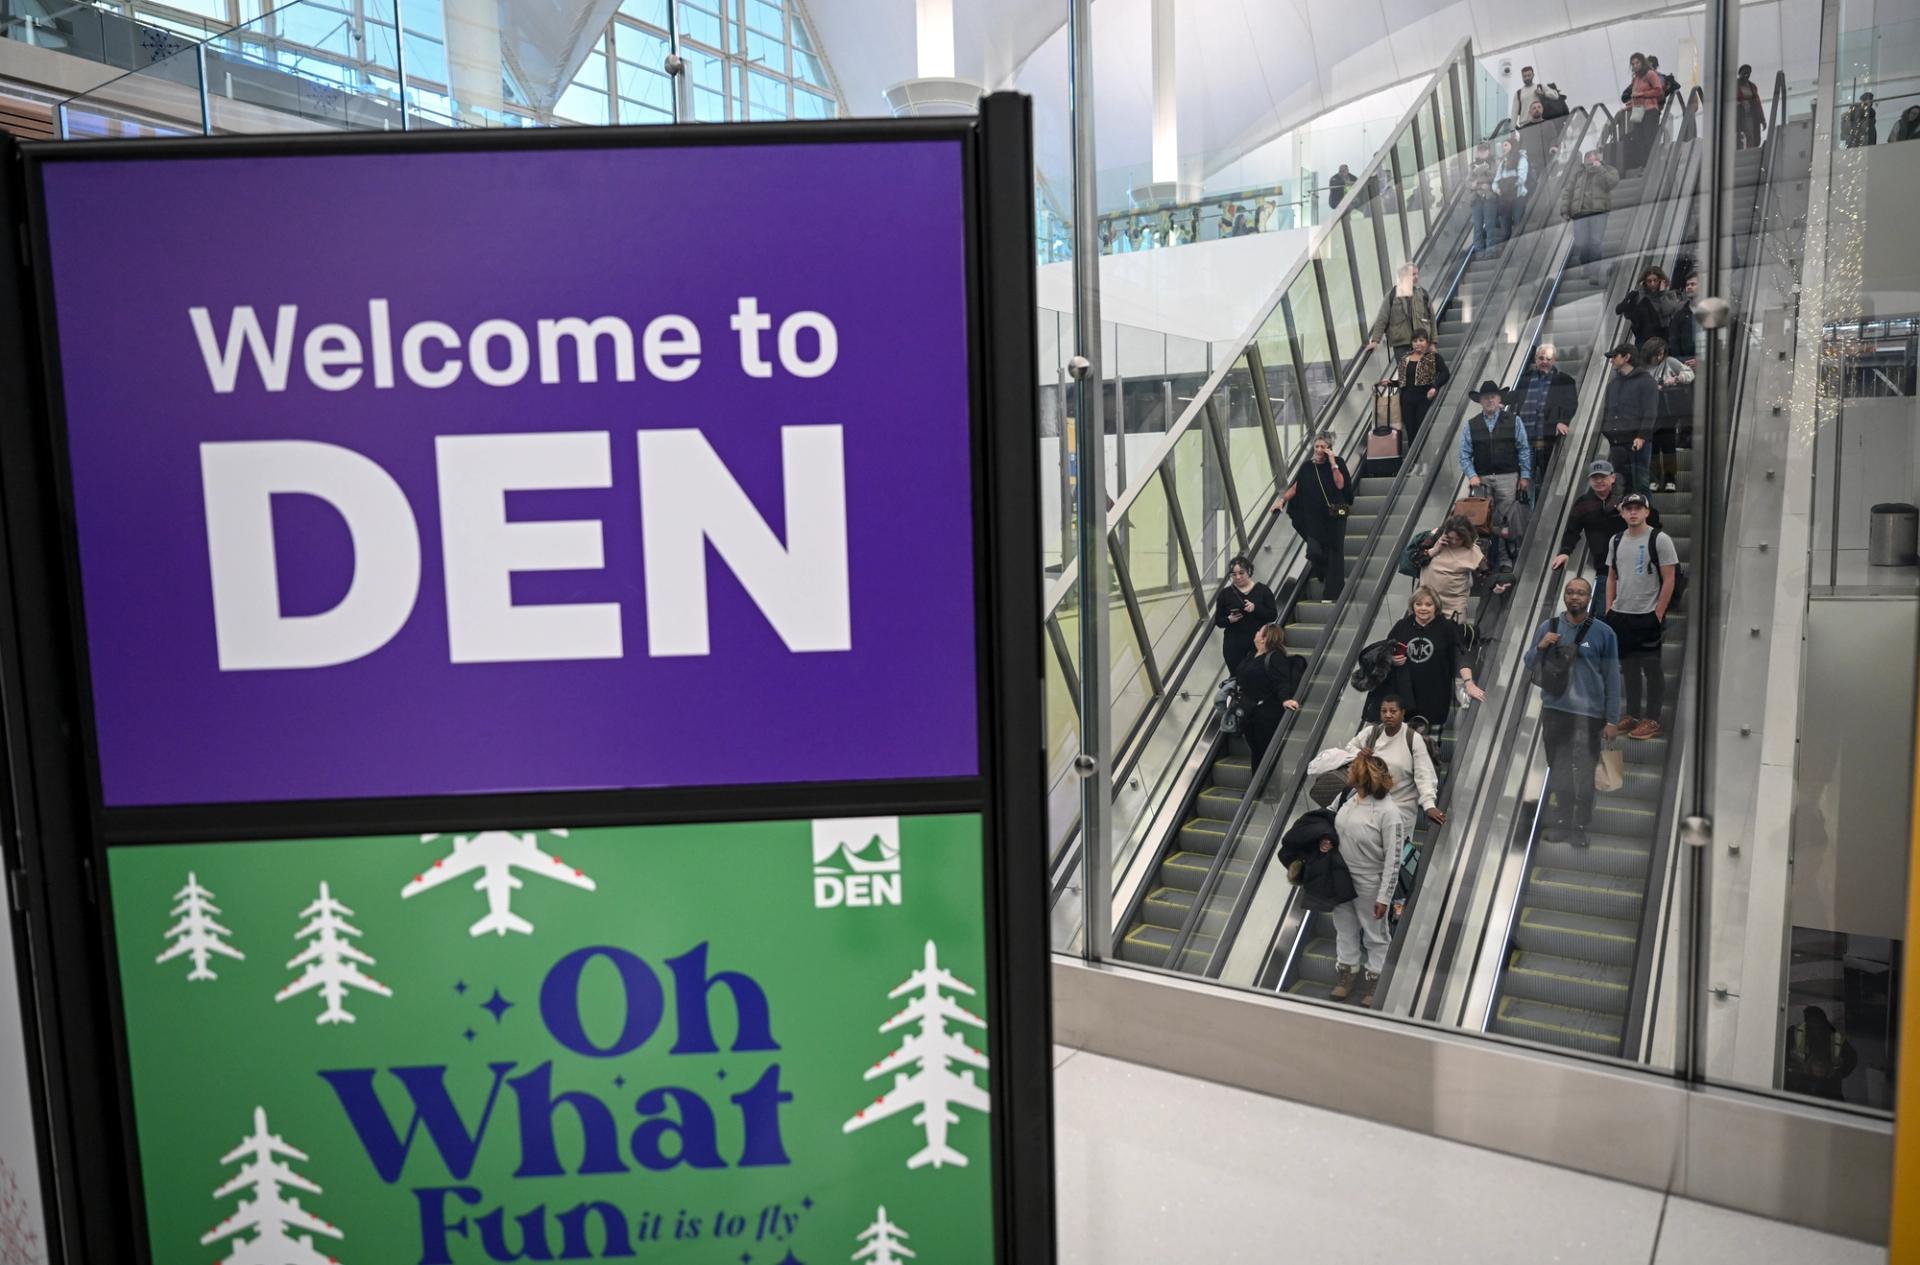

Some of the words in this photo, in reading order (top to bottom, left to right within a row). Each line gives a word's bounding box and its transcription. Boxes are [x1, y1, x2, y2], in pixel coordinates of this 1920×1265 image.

[189, 298, 701, 393] Welcome
[730, 297, 838, 378] to
[199, 424, 852, 671] DEN
[814, 873, 902, 908] DEN
[538, 941, 782, 1059] Oh
[317, 1060, 794, 1185] What
[411, 1186, 636, 1265] Fun
[638, 1211, 663, 1242] it
[674, 1210, 703, 1241] is
[713, 1211, 747, 1239] to
[755, 1204, 799, 1242] fly
